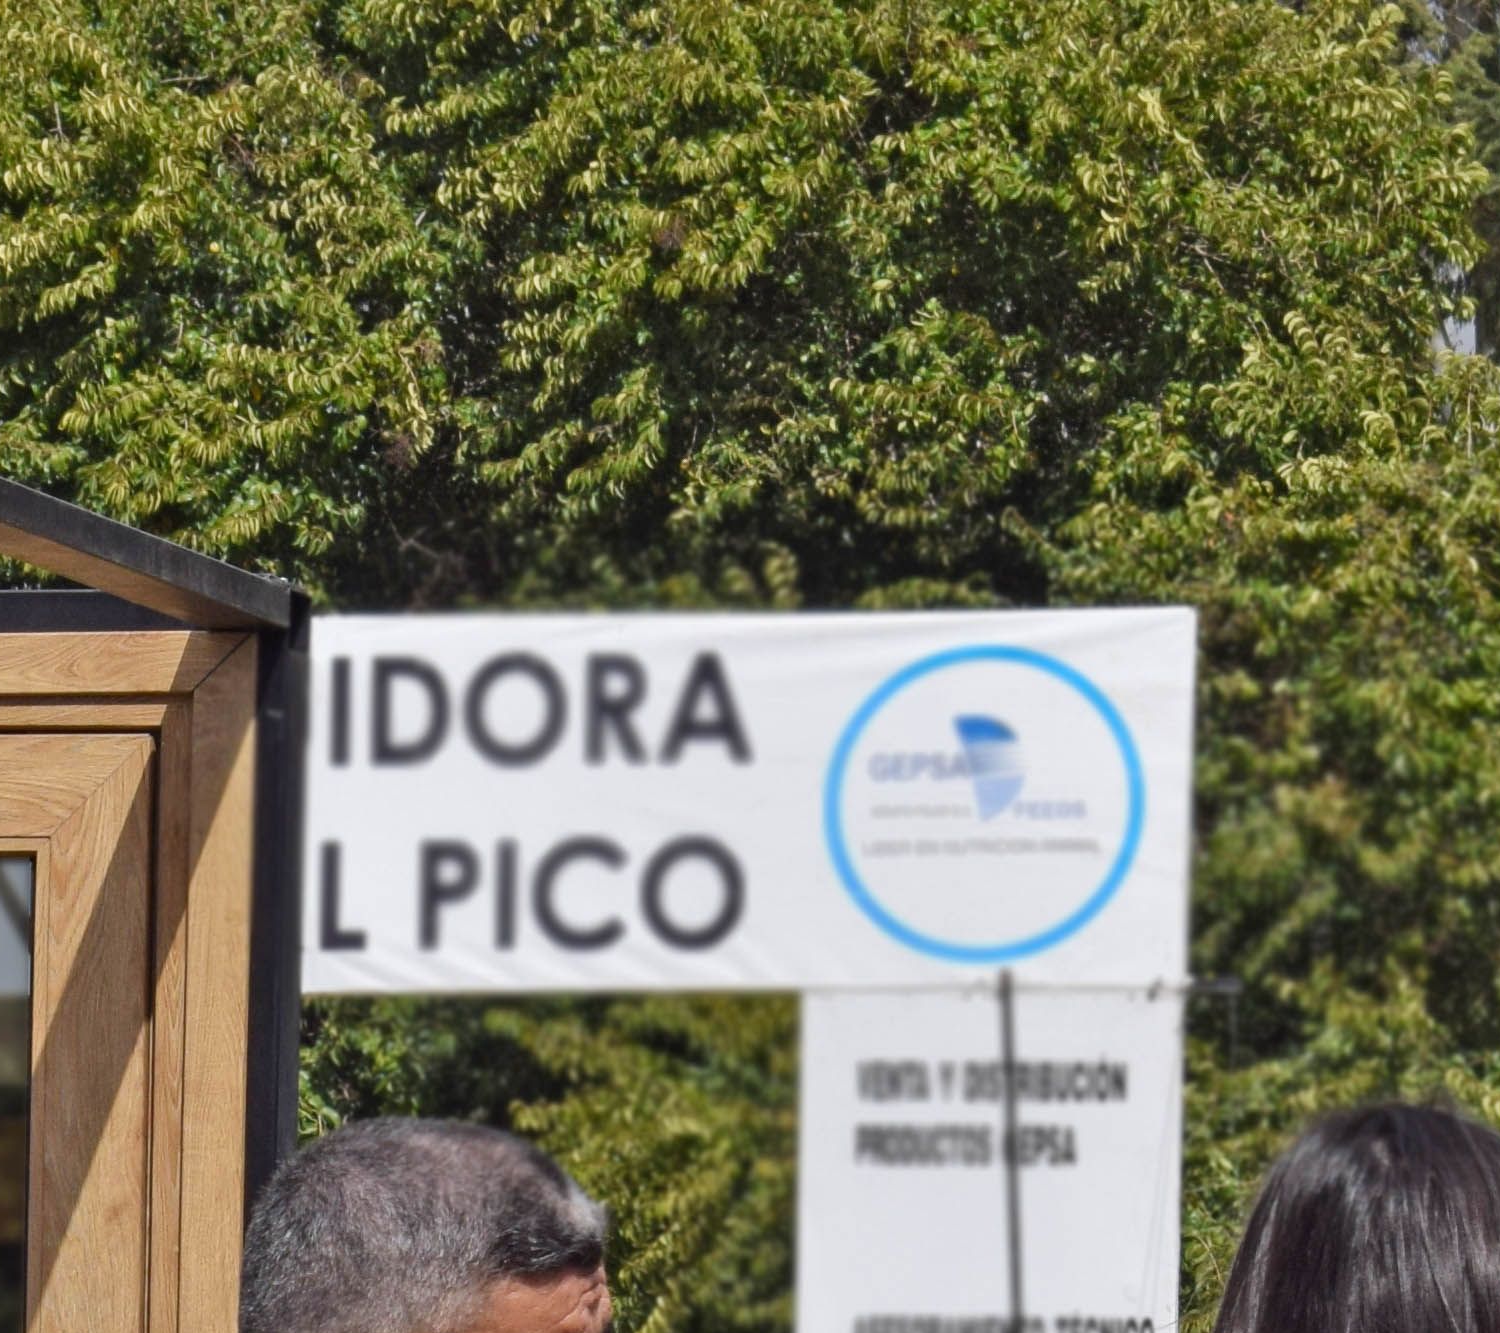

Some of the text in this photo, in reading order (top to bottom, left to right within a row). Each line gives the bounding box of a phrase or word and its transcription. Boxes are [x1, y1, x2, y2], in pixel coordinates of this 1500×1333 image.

[330, 651, 754, 768] IDORA
[417, 834, 747, 953] PICO
[856, 1053, 1128, 1102] VENTA Y DISRIBUCIÓN
[855, 1123, 993, 1167] PRODUCTOS
